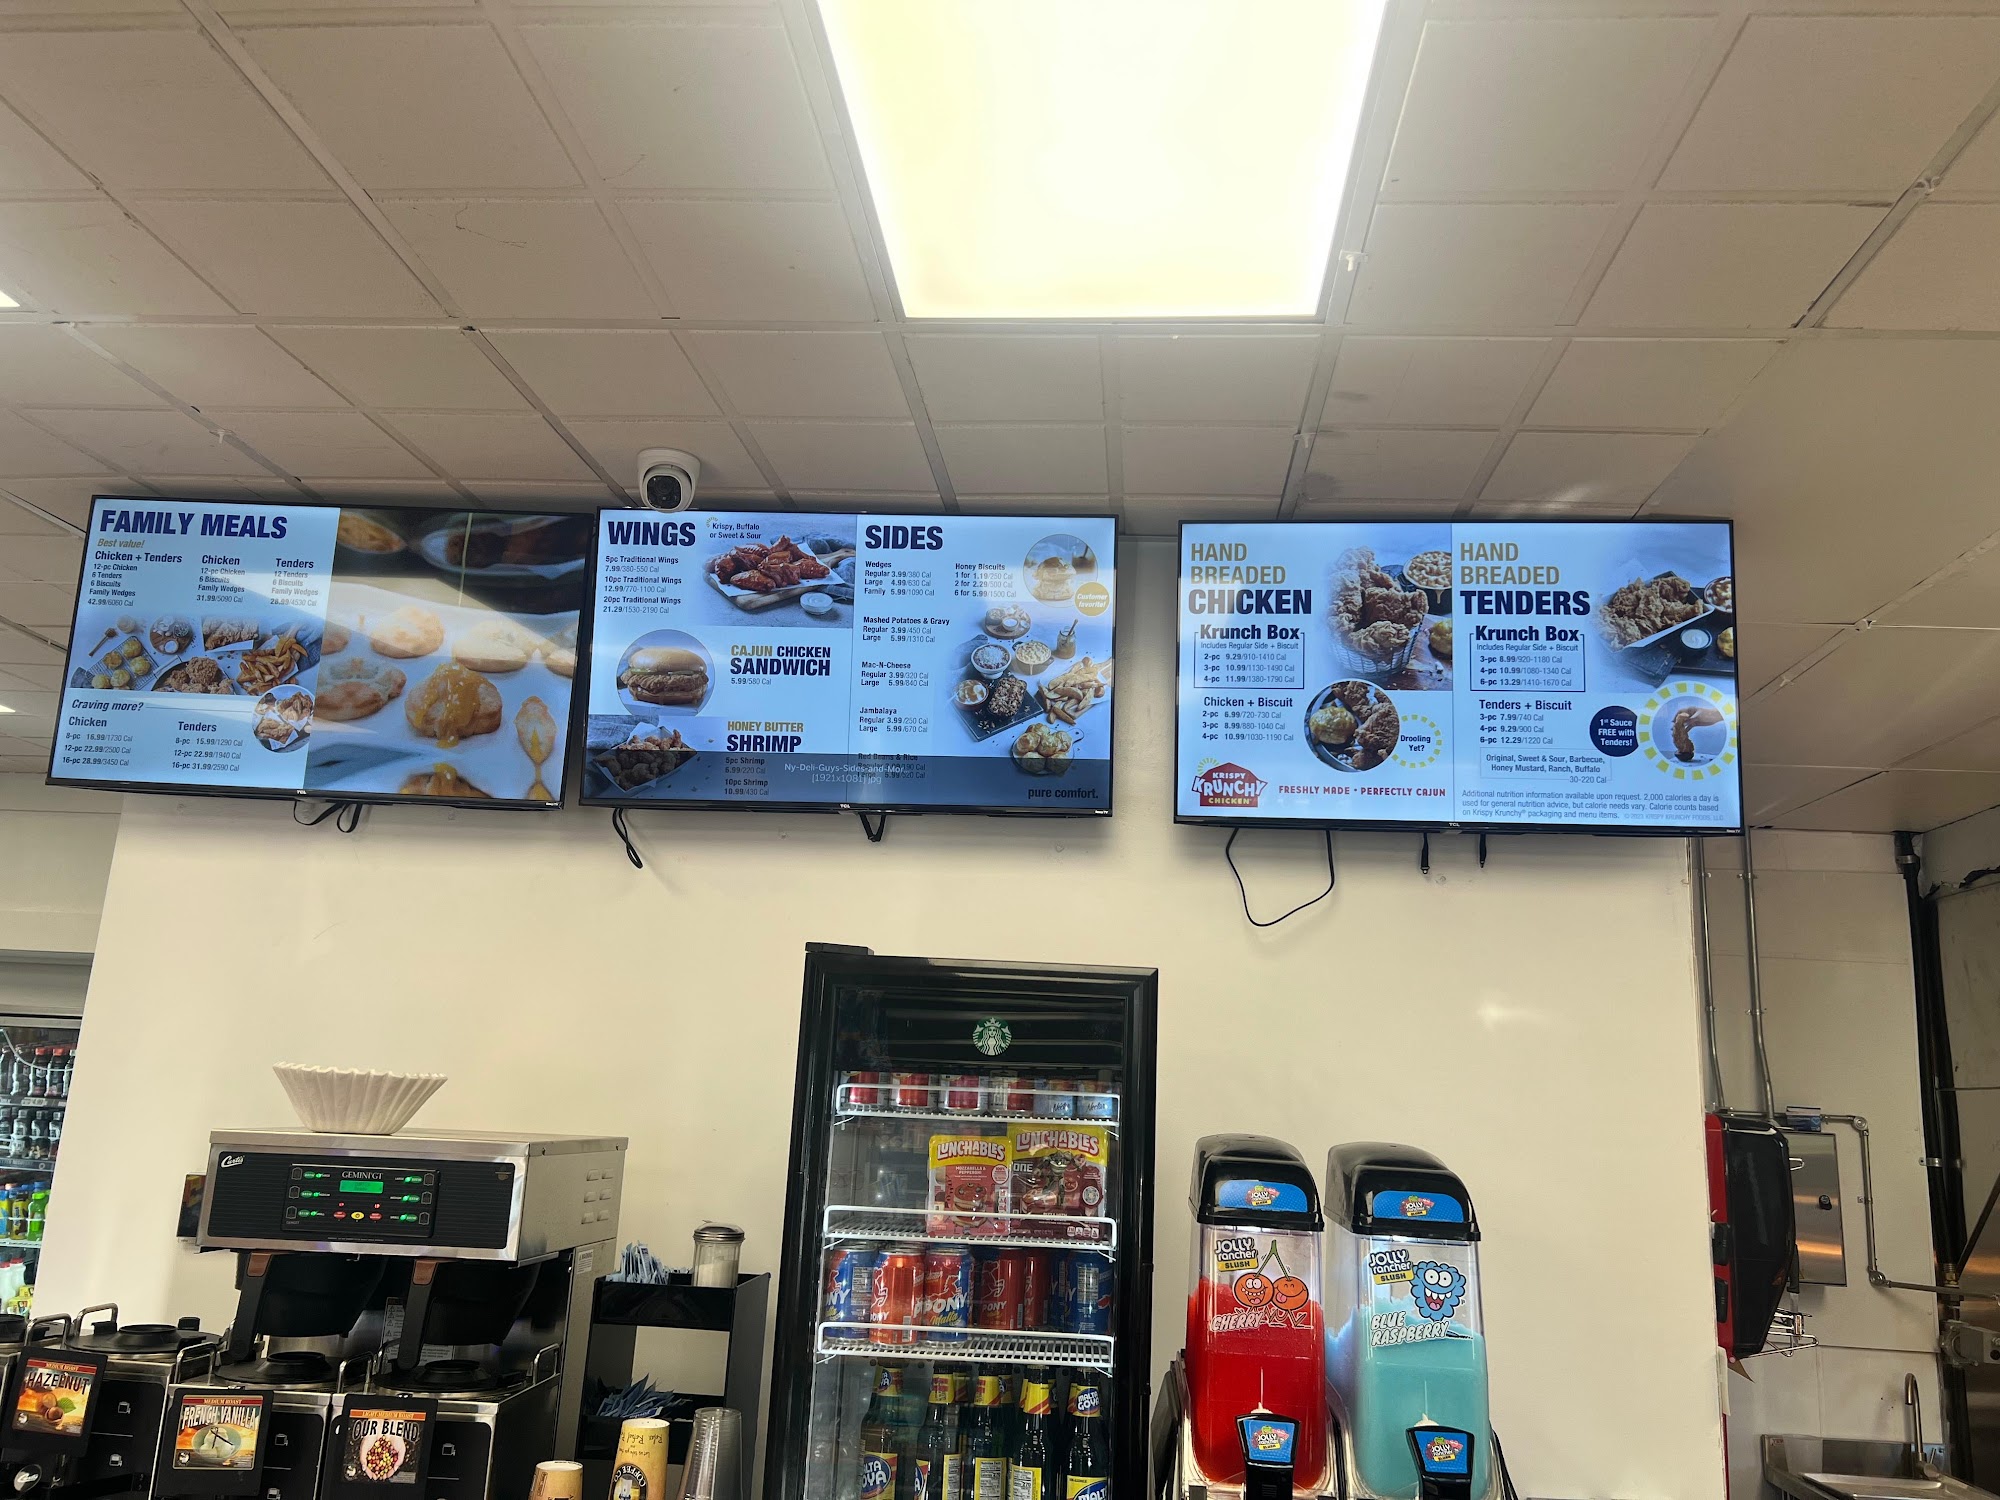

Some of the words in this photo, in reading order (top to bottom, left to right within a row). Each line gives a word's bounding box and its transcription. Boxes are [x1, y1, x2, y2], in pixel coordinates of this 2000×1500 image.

[100, 509, 195, 535] FAMILY
[200, 513, 288, 539] MEALS
[712, 522, 735, 531] Krispy,
[736, 522, 760, 531] Buffalo
[608, 521, 696, 547] WINGS
[717, 531, 739, 539] Sweet
[746, 532, 762, 540] Sour
[865, 525, 943, 550] SIDES
[97, 538, 117, 548] Best
[118, 539, 145, 549] value!
[95, 550, 133, 561] Chicken
[144, 552, 182, 563] Tenders
[1191, 543, 1247, 562] HAND
[1460, 542, 1519, 562] HAND
[201, 554, 240, 566] Chicken
[275, 558, 314, 569] Tenders
[605, 555, 618, 564] 5pc
[619, 555, 656, 563] Traditional
[658, 556, 679, 564] Wings
[865, 560, 892, 569] Wedges
[93, 563, 111, 571] 12-pc
[112, 563, 138, 571] Chicken
[955, 563, 976, 571] Honey
[978, 563, 1006, 571] Biscuits
[604, 575, 622, 584] 10pc
[623, 575, 660, 584] Traditional
[661, 576, 682, 585] Wings
[1190, 565, 1286, 585] BREADED
[1460, 565, 1560, 585] BREADED
[89, 588, 110, 597] Family
[111, 588, 136, 597] Wedges
[197, 584, 219, 593] Family
[219, 585, 245, 594] Wedges
[1188, 589, 1312, 615] CHICKEN
[1460, 590, 1591, 616] TENDERS
[863, 616, 890, 624] Mashed
[891, 616, 922, 625] Potatoes
[922, 617, 929, 625] &
[930, 617, 951, 626] Gravy
[1200, 624, 1262, 640] Krunch
[1267, 624, 1300, 640] Box
[1475, 625, 1540, 641] Krunch
[1545, 625, 1580, 641] Box
[730, 645, 773, 657] CAJUN
[776, 645, 831, 658] CHICKEN
[1200, 641, 1227, 649] Includes
[1228, 641, 1253, 650] Regular
[1276, 642, 1299, 650] Biscuit
[1476, 643, 1504, 651] Includes
[1505, 643, 1531, 652] Regular
[1532, 643, 1547, 651] Side
[1555, 644, 1579, 652] Biscuit
[730, 657, 831, 676] SANDWICH
[861, 661, 912, 669] Mac-N-Cheese
[71, 698, 110, 712] Craving
[111, 701, 144, 711] more?
[1203, 696, 1244, 707] Chicken
[1257, 697, 1293, 708] Biscuit
[1478, 699, 1521, 710] Tenders
[1535, 700, 1572, 711] Biscuit
[859, 707, 897, 716] Jambalaya
[1479, 713, 1497, 721] 3-pc
[68, 716, 107, 727] Chicken
[178, 721, 217, 732] Tenders
[727, 720, 762, 732] HONEY
[764, 721, 804, 733] BUTTER
[1610, 718, 1633, 727] Sauce
[1479, 725, 1497, 733] 4-pc
[1533, 725, 1544, 733] Cal
[1598, 728, 1617, 736] FREE
[1618, 729, 1635, 737] with
[726, 734, 802, 752] SHRIMP
[1400, 734, 1431, 744] Drooling
[1479, 736, 1498, 745] 6-pc
[1542, 737, 1553, 745] Cal
[1600, 738, 1633, 746] Tenders!
[1408, 744, 1425, 752] Yet?
[725, 757, 739, 766] 5pc
[740, 757, 765, 766] Shrimp
[1486, 754, 1516, 763] Original,
[1548, 755, 1568, 764] Sour,
[1569, 756, 1605, 764] Barbecue,
[1491, 764, 1513, 772] Honey
[1514, 764, 1547, 772] Mustard,
[1548, 765, 1573, 773] Ranch,
[1574, 765, 1600, 773] Buffalo
[1192, 775, 1268, 797] KRUNCHY
[1279, 785, 1320, 794] FRESHLY
[1323, 786, 1350, 795] MADE
[1360, 787, 1413, 796] PERFECTLY
[1416, 787, 1446, 797] CAJUN
[1028, 789, 1052, 799] pure
[1054, 787, 1099, 799] comfort.
[1461, 789, 1495, 798] Additional
[1525, 791, 1564, 799] information
[1564, 792, 1595, 800] available
[1596, 793, 1613, 801] upon
[1614, 794, 1642, 802] request.
[1643, 793, 1663, 802] 2,000
[1664, 794, 1691, 802] calories
[1699, 795, 1712, 803] day
[1208, 797, 1251, 805] CHICKEN
[1016, 1130, 1100, 1157] LUNCHABLES
[937, 1140, 1006, 1161] LUNCHABLES
[1214, 1237, 1254, 1254] JOLLY
[1217, 1249, 1257, 1262] rancher
[1369, 1249, 1409, 1267] JOLLY
[1224, 1260, 1251, 1269] SLUSH
[1373, 1261, 1412, 1274] rancher
[1380, 1272, 1407, 1282] SLUSH
[923, 1291, 968, 1314] PONY
[1210, 1311, 1263, 1332] CHERRY
[1371, 1311, 1406, 1331] BLUE
[1371, 1321, 1450, 1347] RASPBERRY
[27, 1371, 90, 1395] HAZELNUT
[181, 1406, 219, 1430] FRENCH
[220, 1406, 257, 1430] VANILLA
[353, 1419, 378, 1440] OUR
[381, 1420, 420, 1442] BLEND
[621, 1465, 646, 1487] COFFEE
